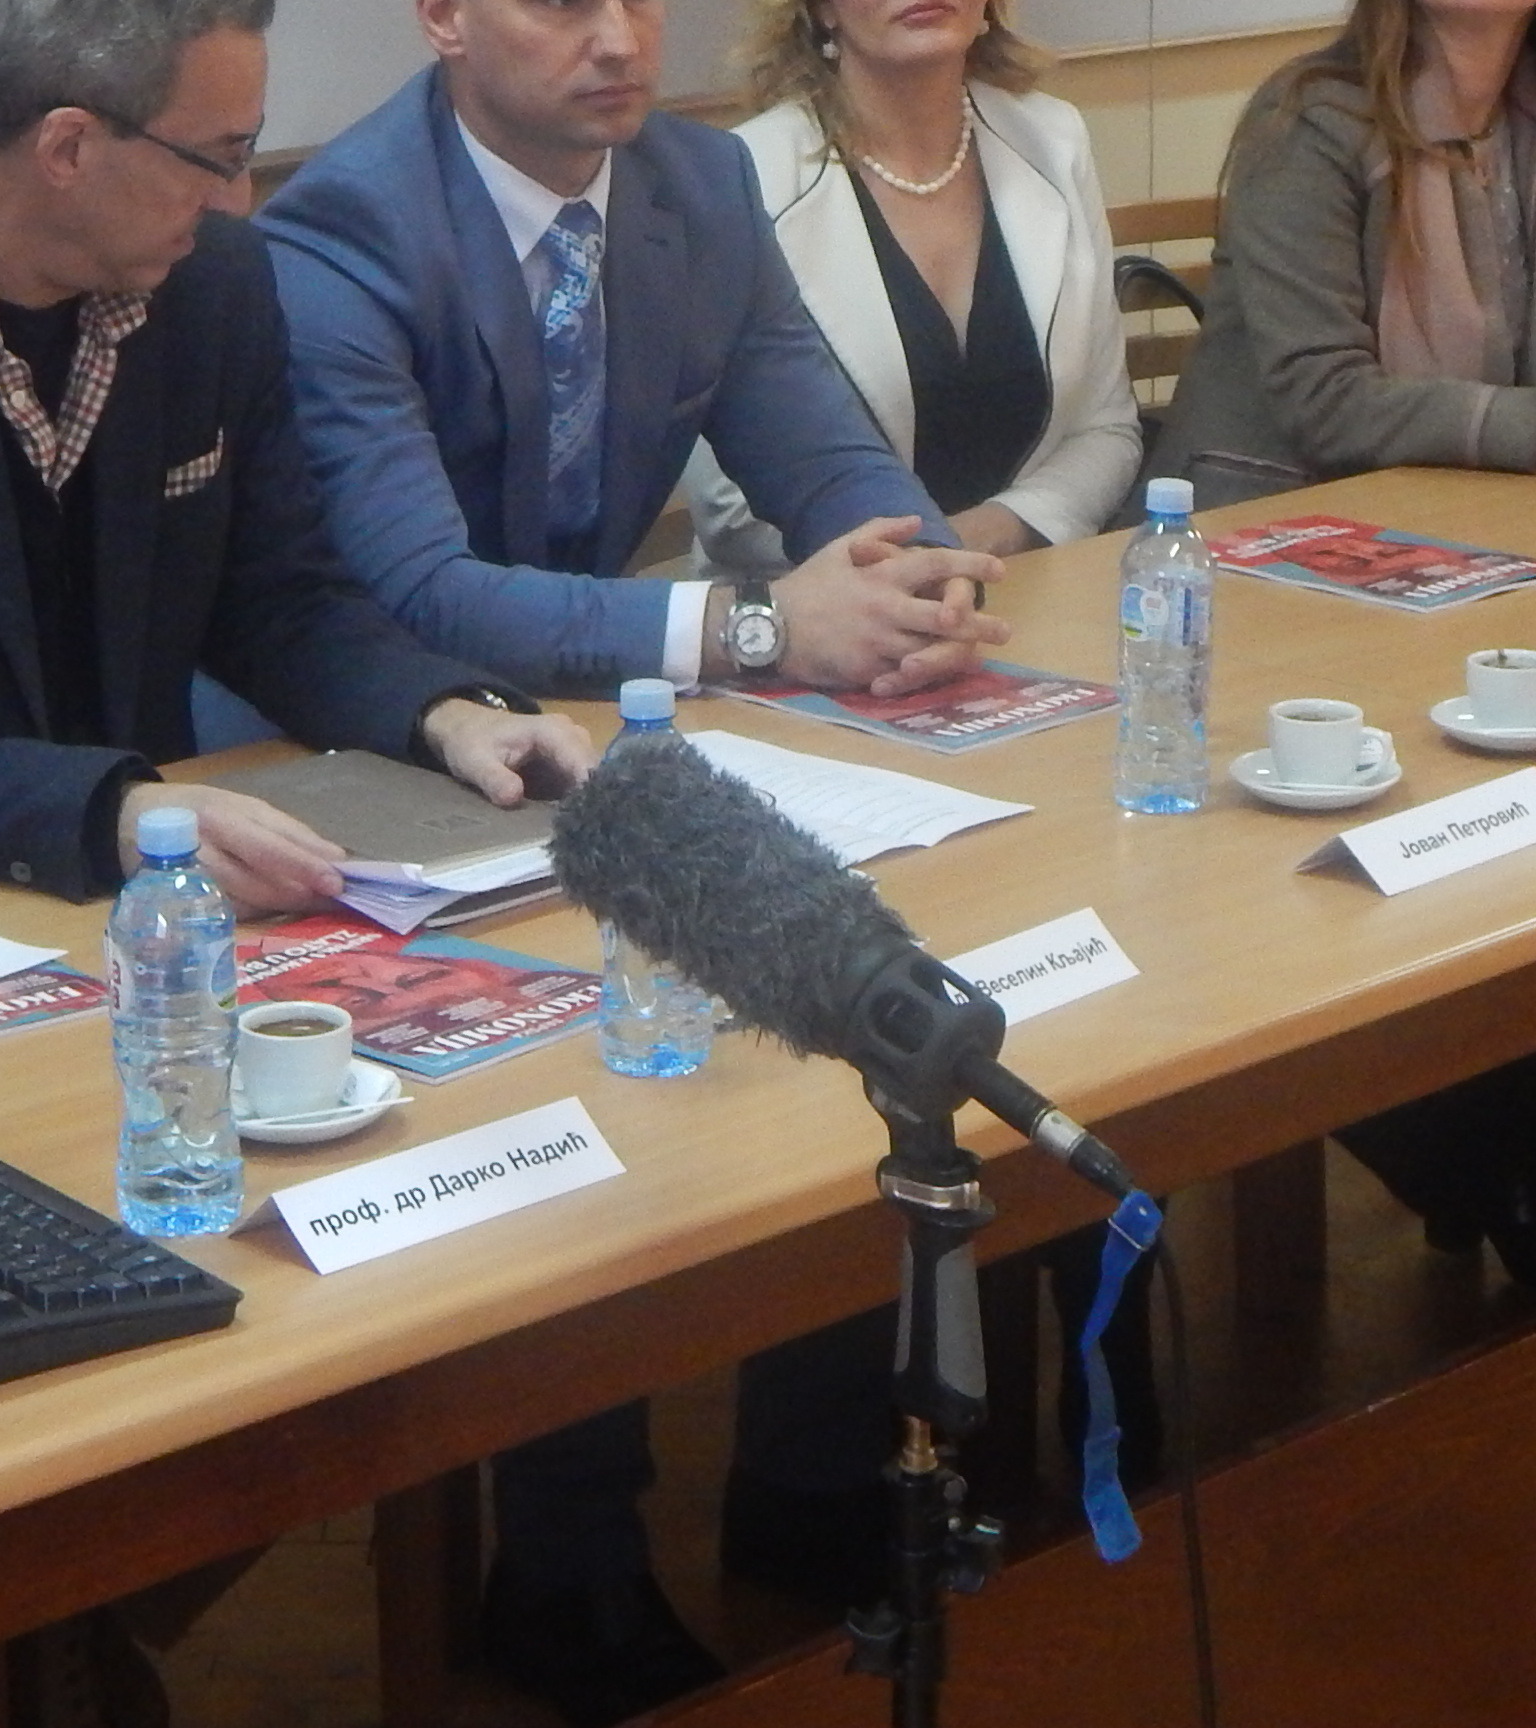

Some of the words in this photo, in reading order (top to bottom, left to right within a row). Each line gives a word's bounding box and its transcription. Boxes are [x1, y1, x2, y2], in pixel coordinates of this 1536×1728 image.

[1399, 830, 1451, 860] Јован
[1447, 800, 1531, 841] Петровић
[1044, 936, 1109, 972] Кљајић
[308, 1197, 390, 1238] проф.
[394, 1185, 427, 1214] др
[428, 1160, 506, 1203] Дарко
[506, 1130, 589, 1173] Надић
